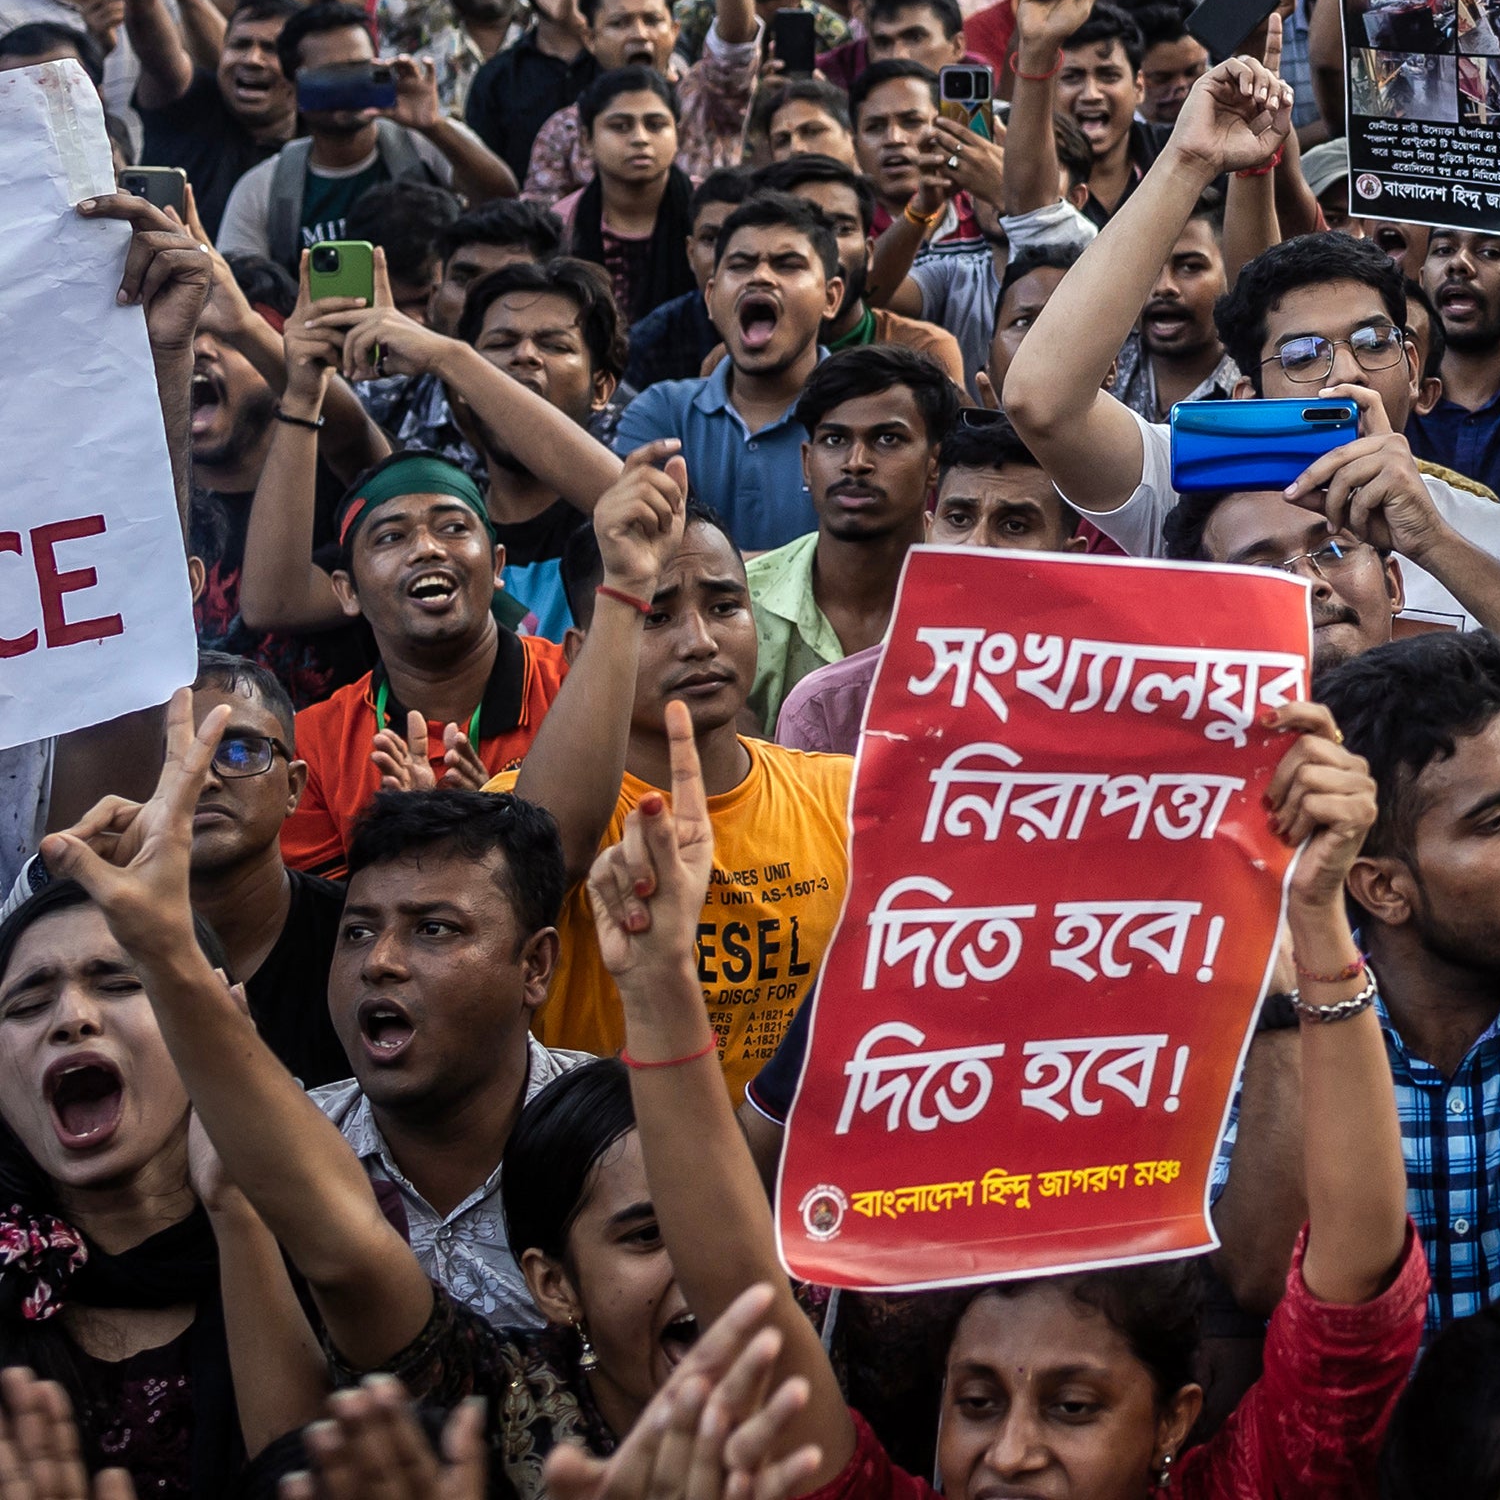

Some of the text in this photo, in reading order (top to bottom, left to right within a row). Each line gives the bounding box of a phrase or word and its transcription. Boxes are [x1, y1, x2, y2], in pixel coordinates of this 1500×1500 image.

[1384, 181, 1447, 203] বাংলাদেশ
[1451, 184, 1482, 211] হিন্দু
[919, 742, 1247, 843] নিরাপত্তা
[764, 862, 791, 884] UNIT
[761, 876, 830, 904] AS-1507-3
[862, 875, 1226, 991] দিতে হবে!
[696, 915, 811, 984] ESEL
[717, 987, 761, 1005] DISCS
[767, 983, 798, 1001] FOR
[709, 1012, 733, 1024] ERS
[711, 1023, 730, 1035] RS
[834, 1020, 1191, 1135] দিতে হবে!
[851, 1179, 976, 1220] বাংলাদেশ
[980, 1167, 1032, 1210] হিন্দু
[1037, 1163, 1128, 1199] জাগরণ
[1133, 1158, 1182, 1188] মঞ্চ
